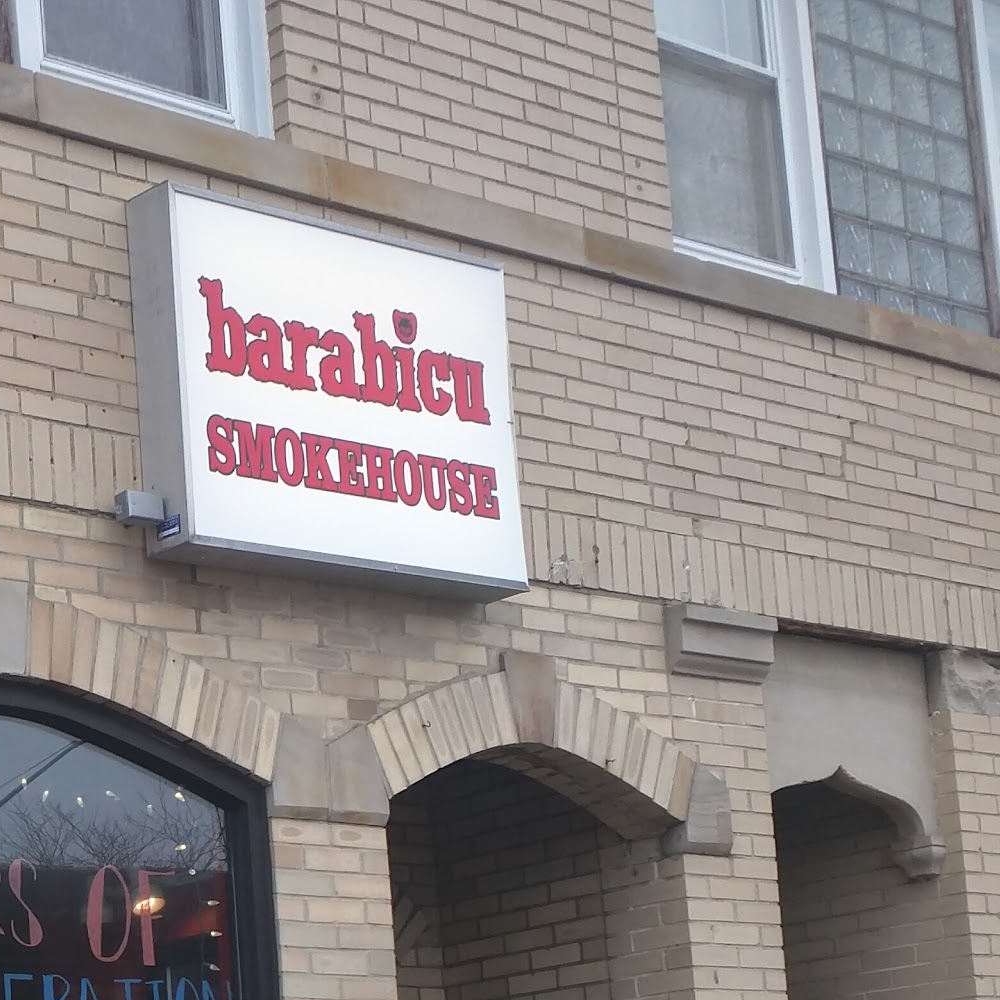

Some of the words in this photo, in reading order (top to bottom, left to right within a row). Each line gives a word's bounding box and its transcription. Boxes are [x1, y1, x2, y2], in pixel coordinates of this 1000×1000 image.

[198, 275, 491, 426] barabicu
[207, 414, 500, 520] SMOKEHOUSE
[87, 864, 176, 966] OF
